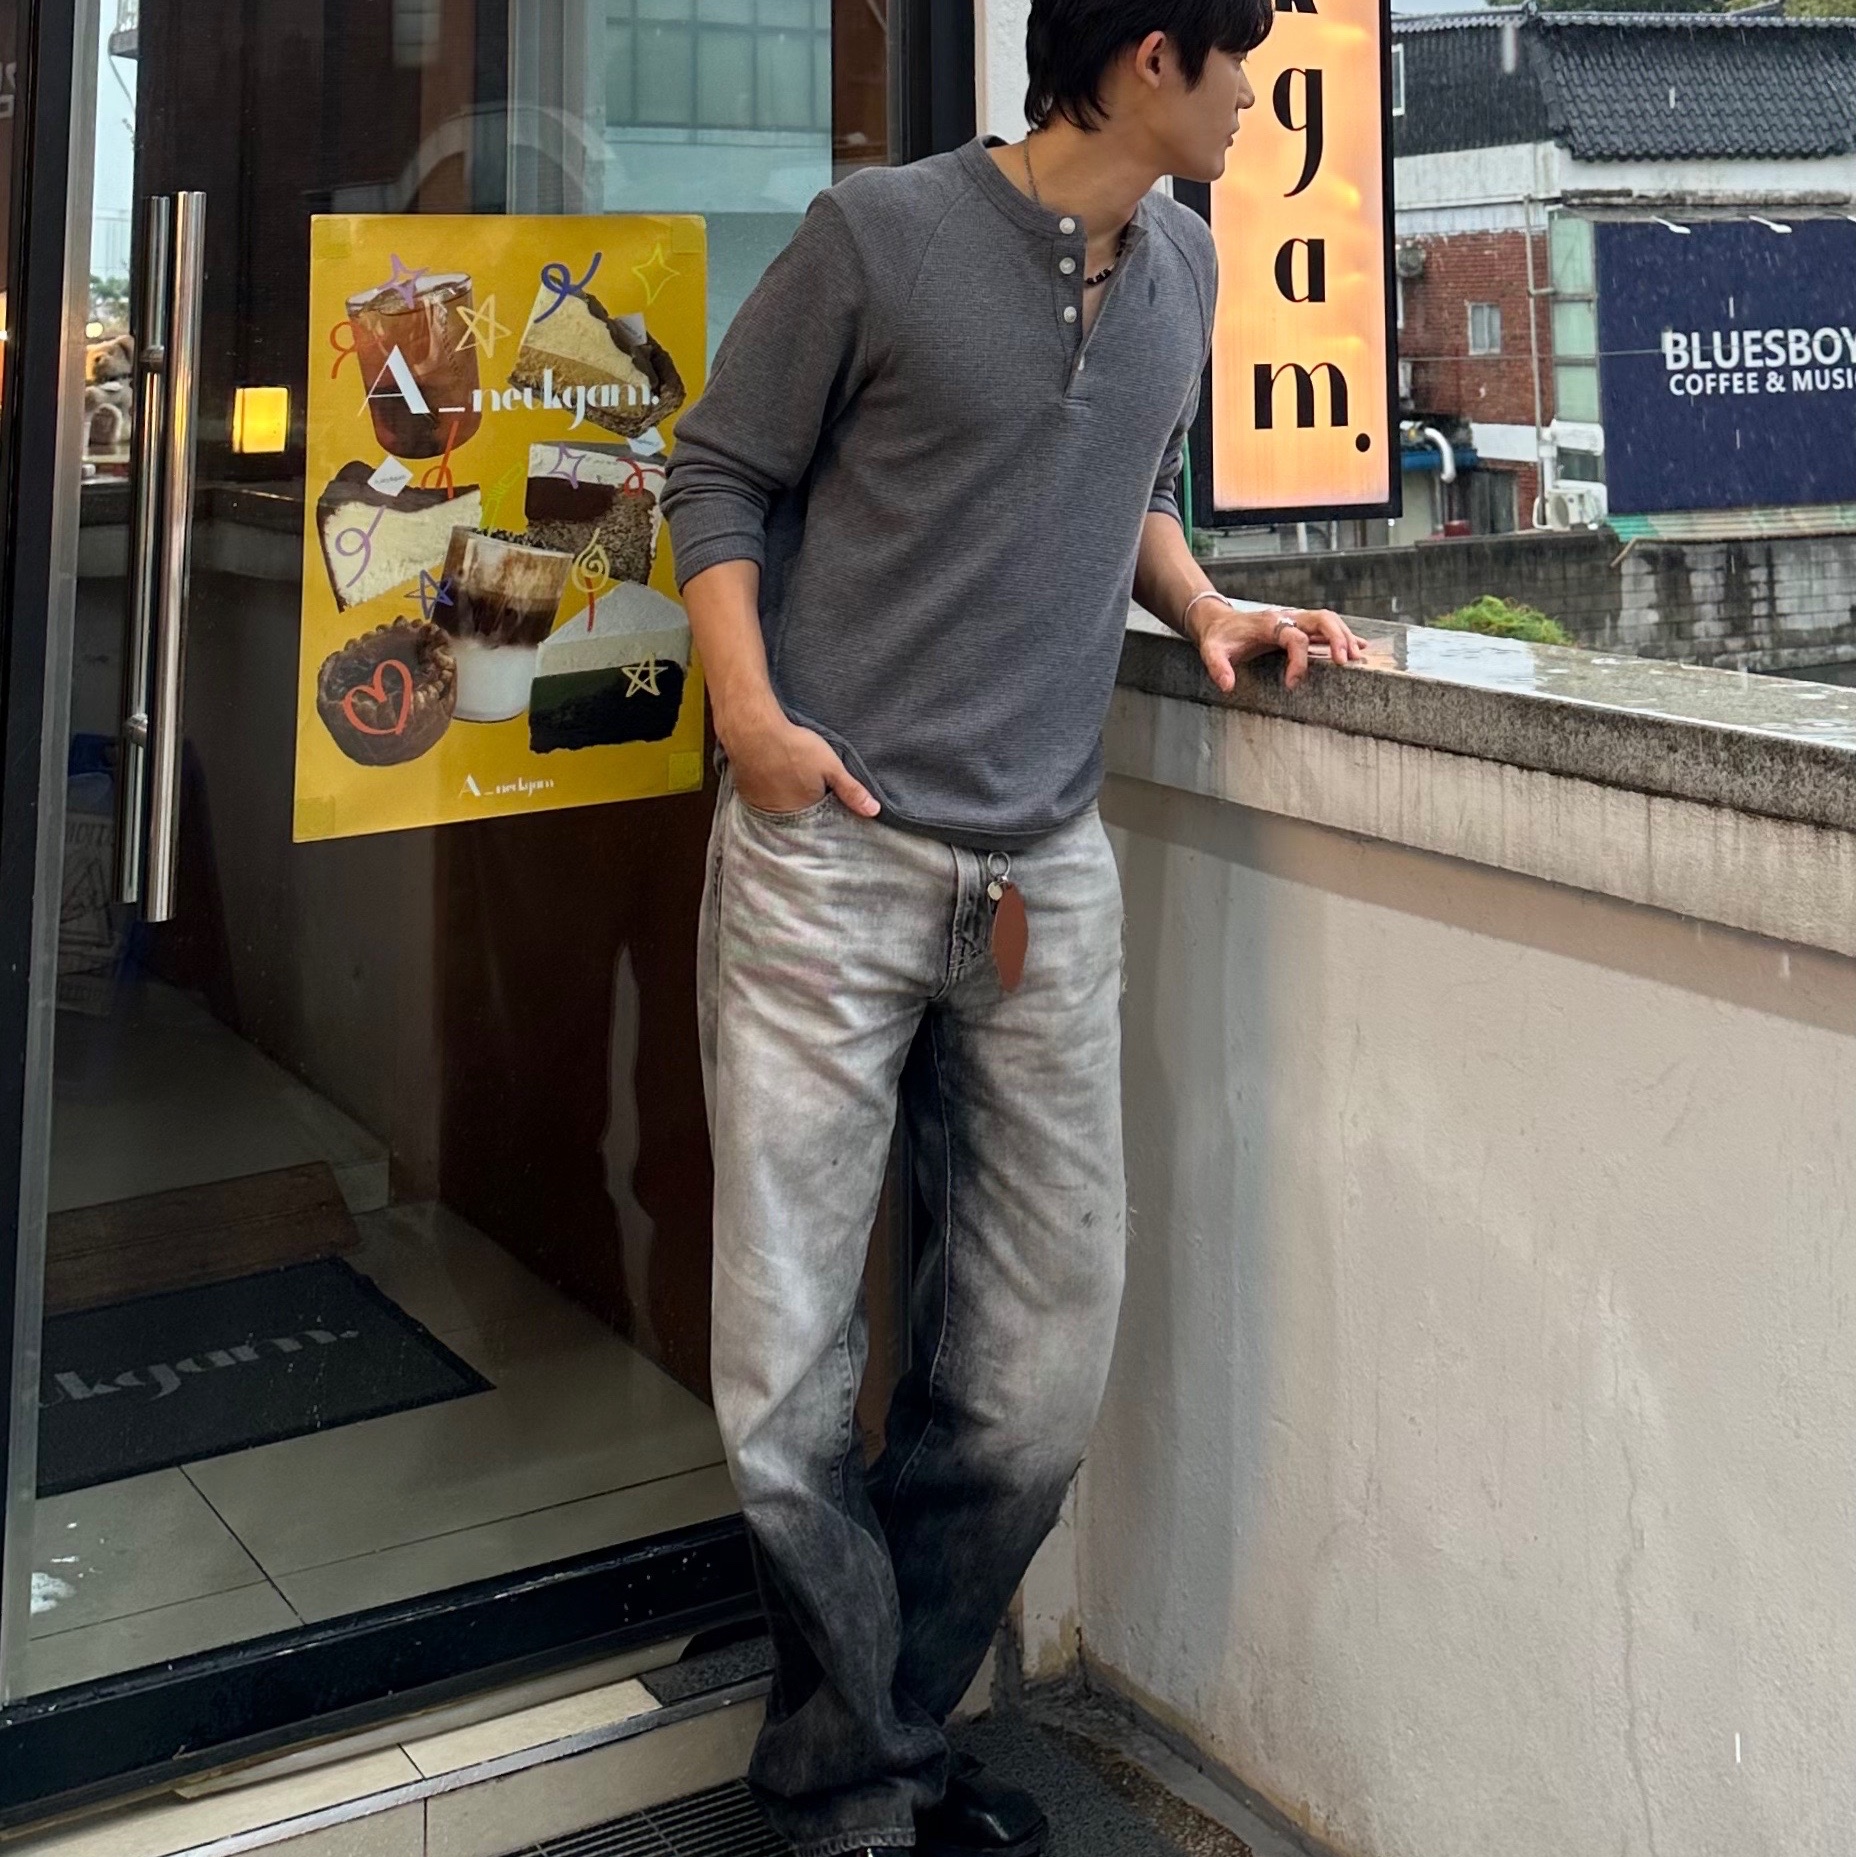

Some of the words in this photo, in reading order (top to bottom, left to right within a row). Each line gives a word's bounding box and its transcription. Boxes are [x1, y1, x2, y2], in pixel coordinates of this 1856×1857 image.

[1253, 0, 1371, 453] gam.
[1669, 373, 1760, 396] COFFEE
[1765, 371, 1786, 393] &
[1792, 368, 1856, 391] MUSI
